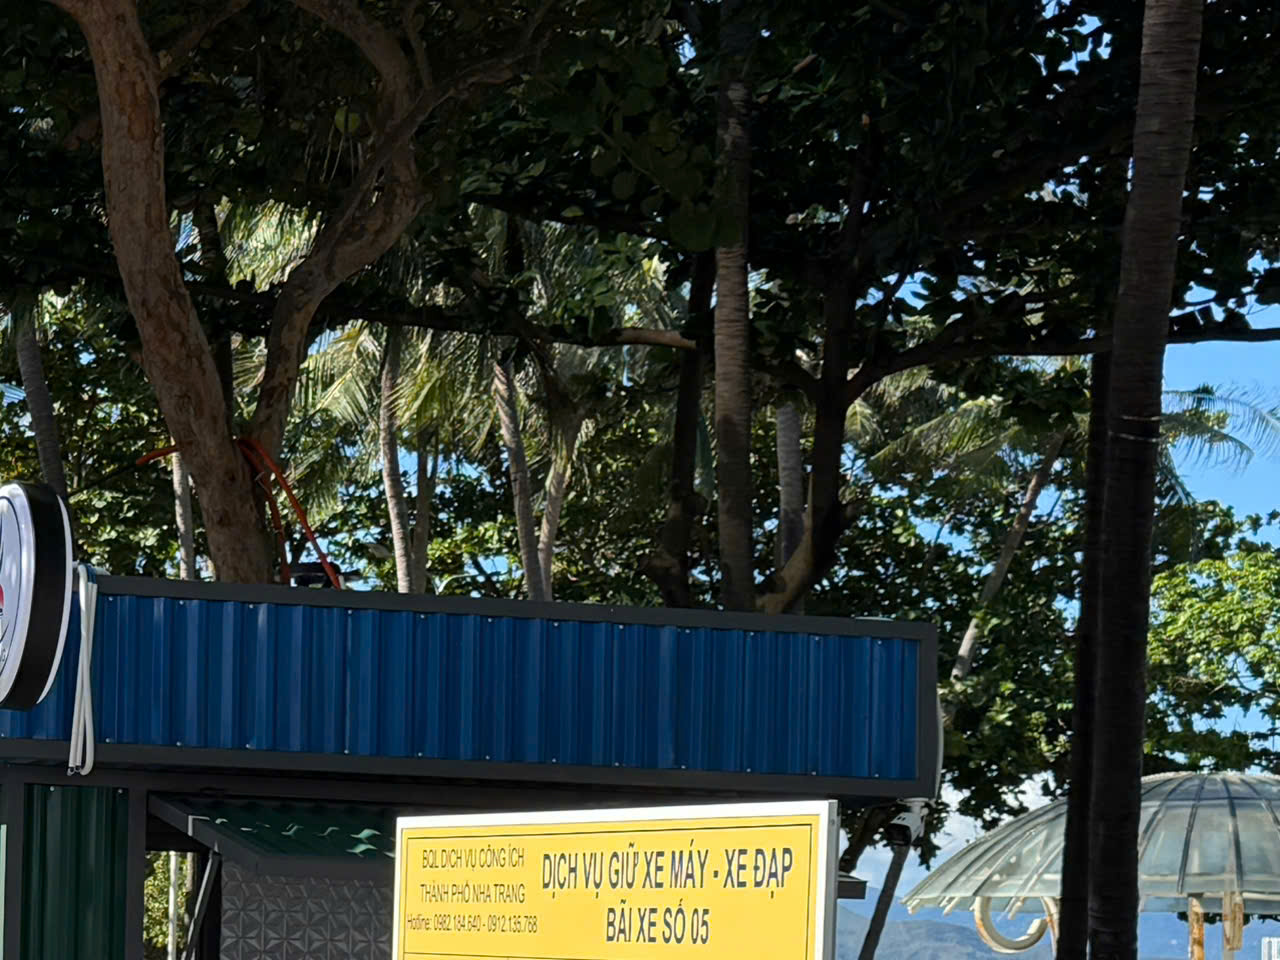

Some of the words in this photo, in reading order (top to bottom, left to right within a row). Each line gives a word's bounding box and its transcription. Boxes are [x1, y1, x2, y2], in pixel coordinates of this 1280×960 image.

[541, 852, 578, 899] DỊCH
[582, 851, 603, 899] VỤ
[608, 841, 639, 889] GIỮ
[641, 850, 665, 888] XE
[669, 837, 709, 889] MÁY
[722, 848, 748, 888] XE
[752, 847, 793, 899] ĐẠP
[605, 898, 632, 943] BÃI
[635, 907, 658, 943] XE
[661, 897, 686, 944] SỐ
[690, 907, 710, 944] 05
